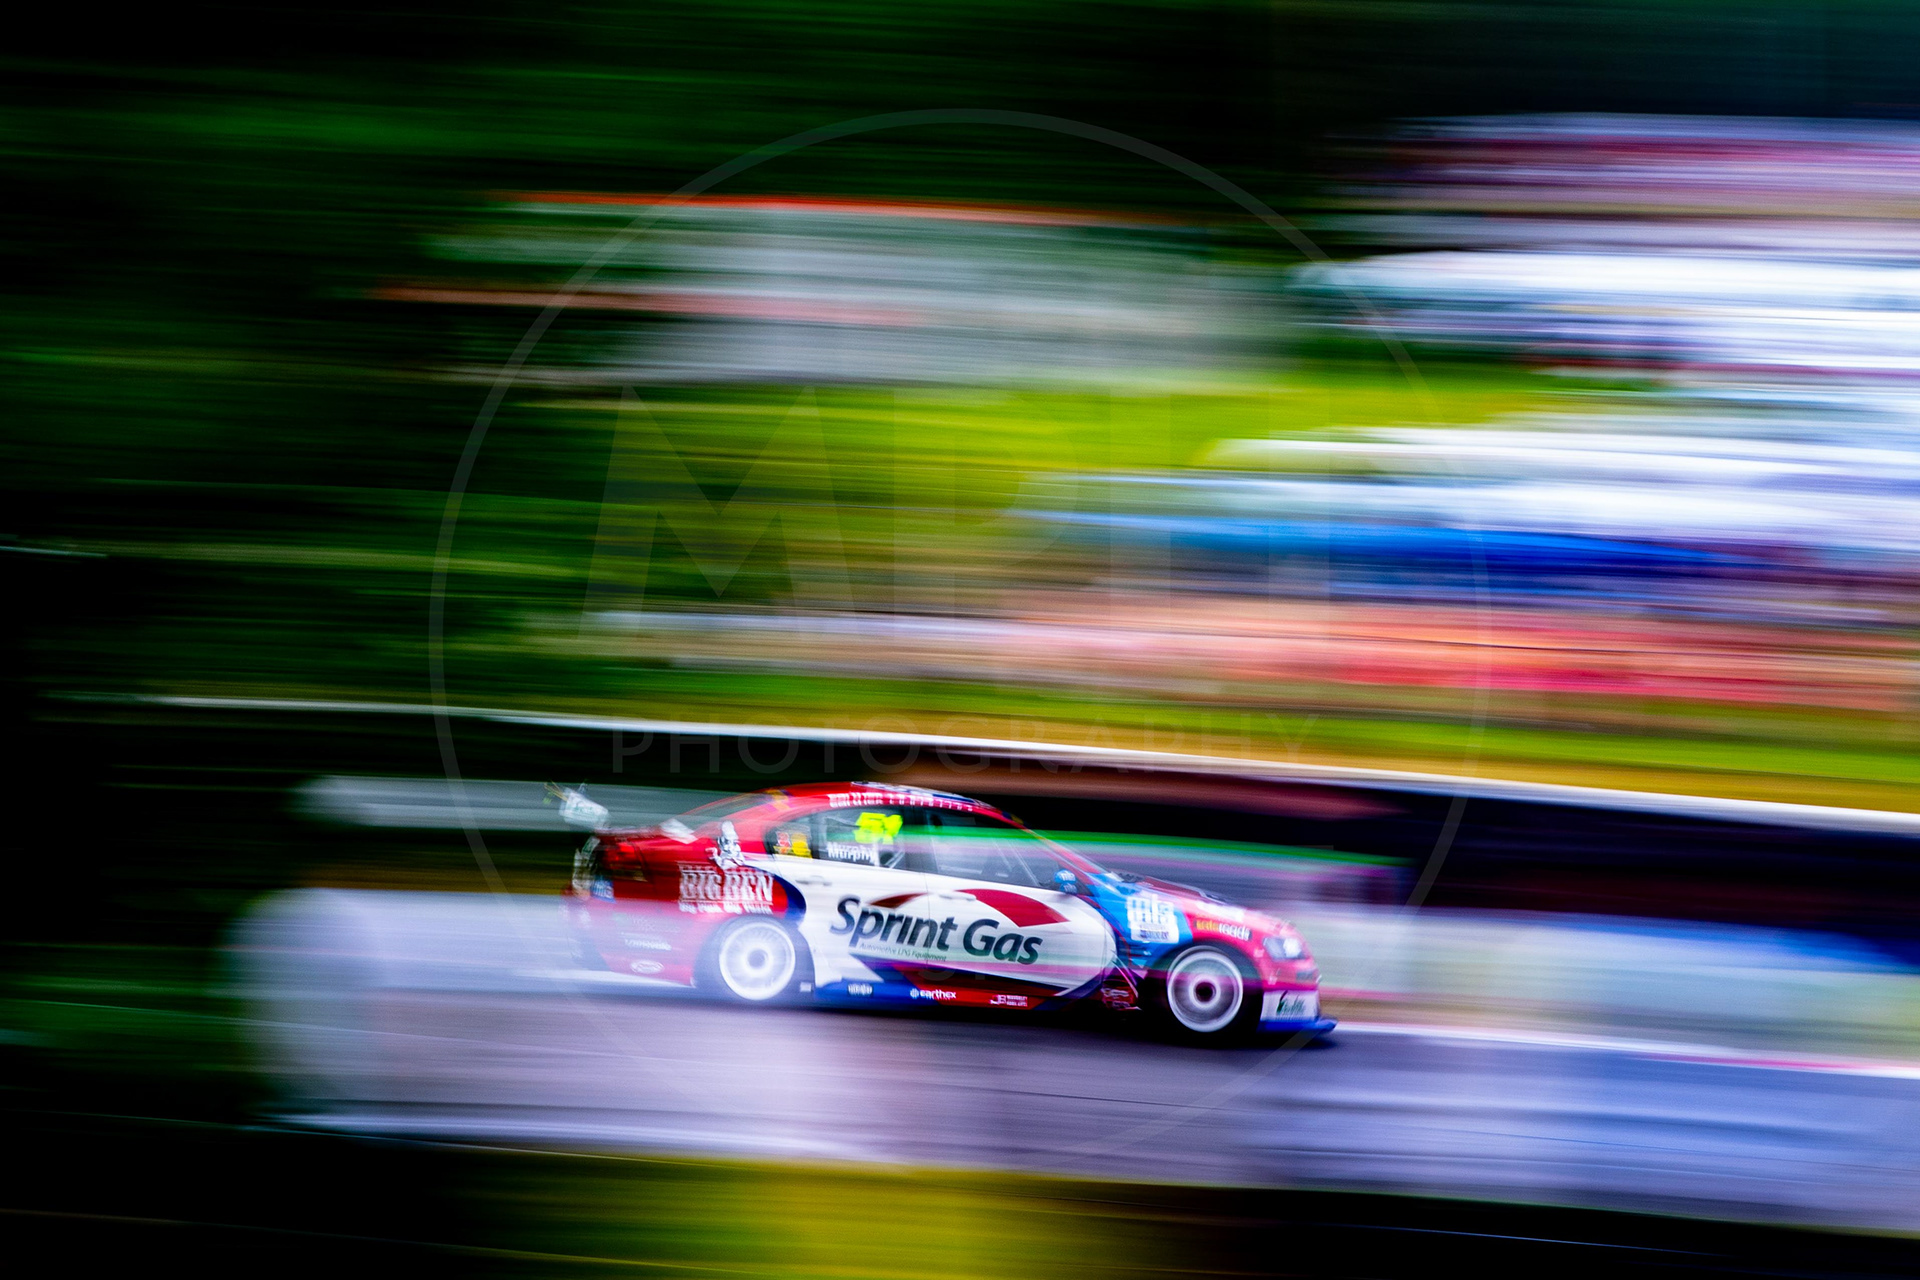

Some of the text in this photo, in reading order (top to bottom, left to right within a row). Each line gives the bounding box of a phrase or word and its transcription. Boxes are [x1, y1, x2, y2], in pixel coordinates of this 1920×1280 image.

[826, 842, 877, 864] Murphy
[679, 870, 774, 903] BIG BEN
[829, 894, 1044, 966] Sprint Gas
[920, 988, 956, 1000] earthex
